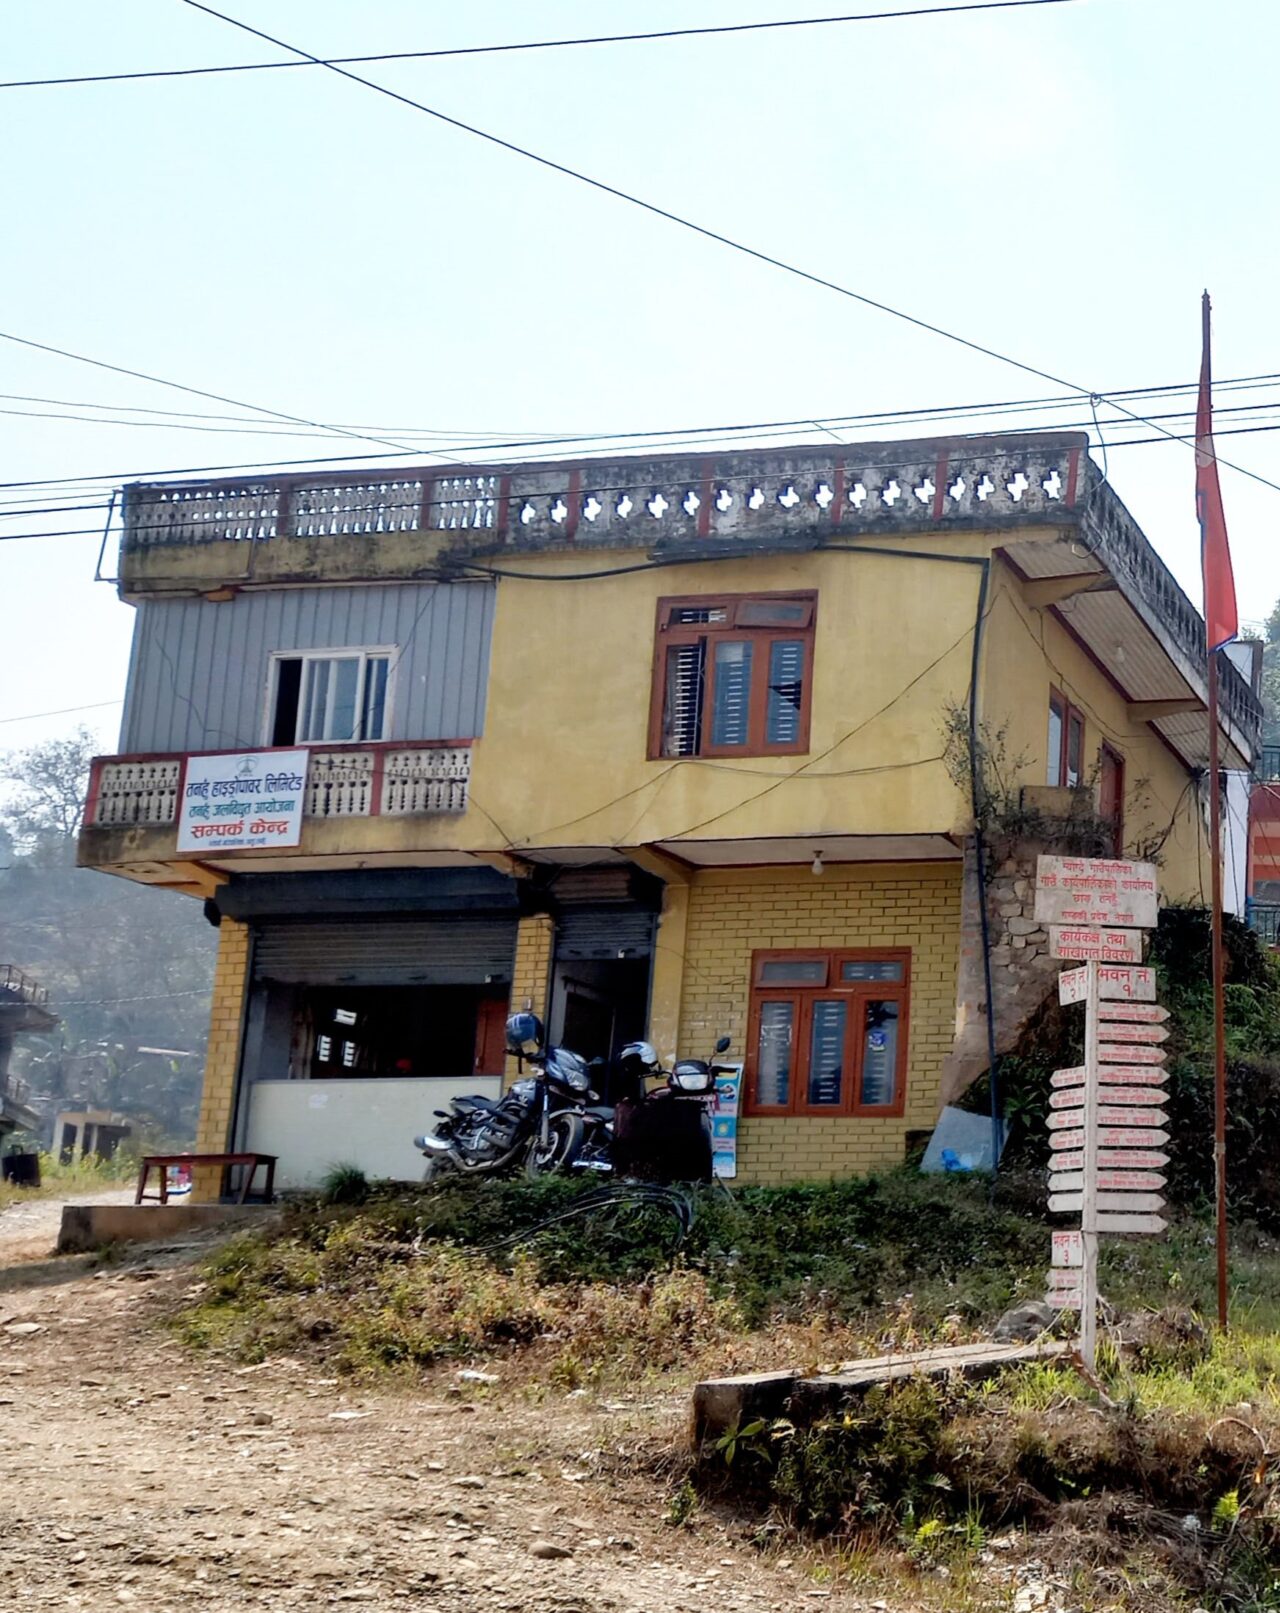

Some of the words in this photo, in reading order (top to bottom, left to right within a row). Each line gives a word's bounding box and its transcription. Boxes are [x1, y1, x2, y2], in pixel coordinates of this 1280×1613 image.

[265, 772, 303, 793] लिमिटेड
[254, 798, 296, 814] आयोजना
[191, 819, 244, 839] सम्पर्क
[249, 818, 289, 835] केन्द्र
[1106, 933, 1126, 945] तथा
[1057, 946, 1099, 958] शाखागत
[1097, 968, 1131, 981] भवन
